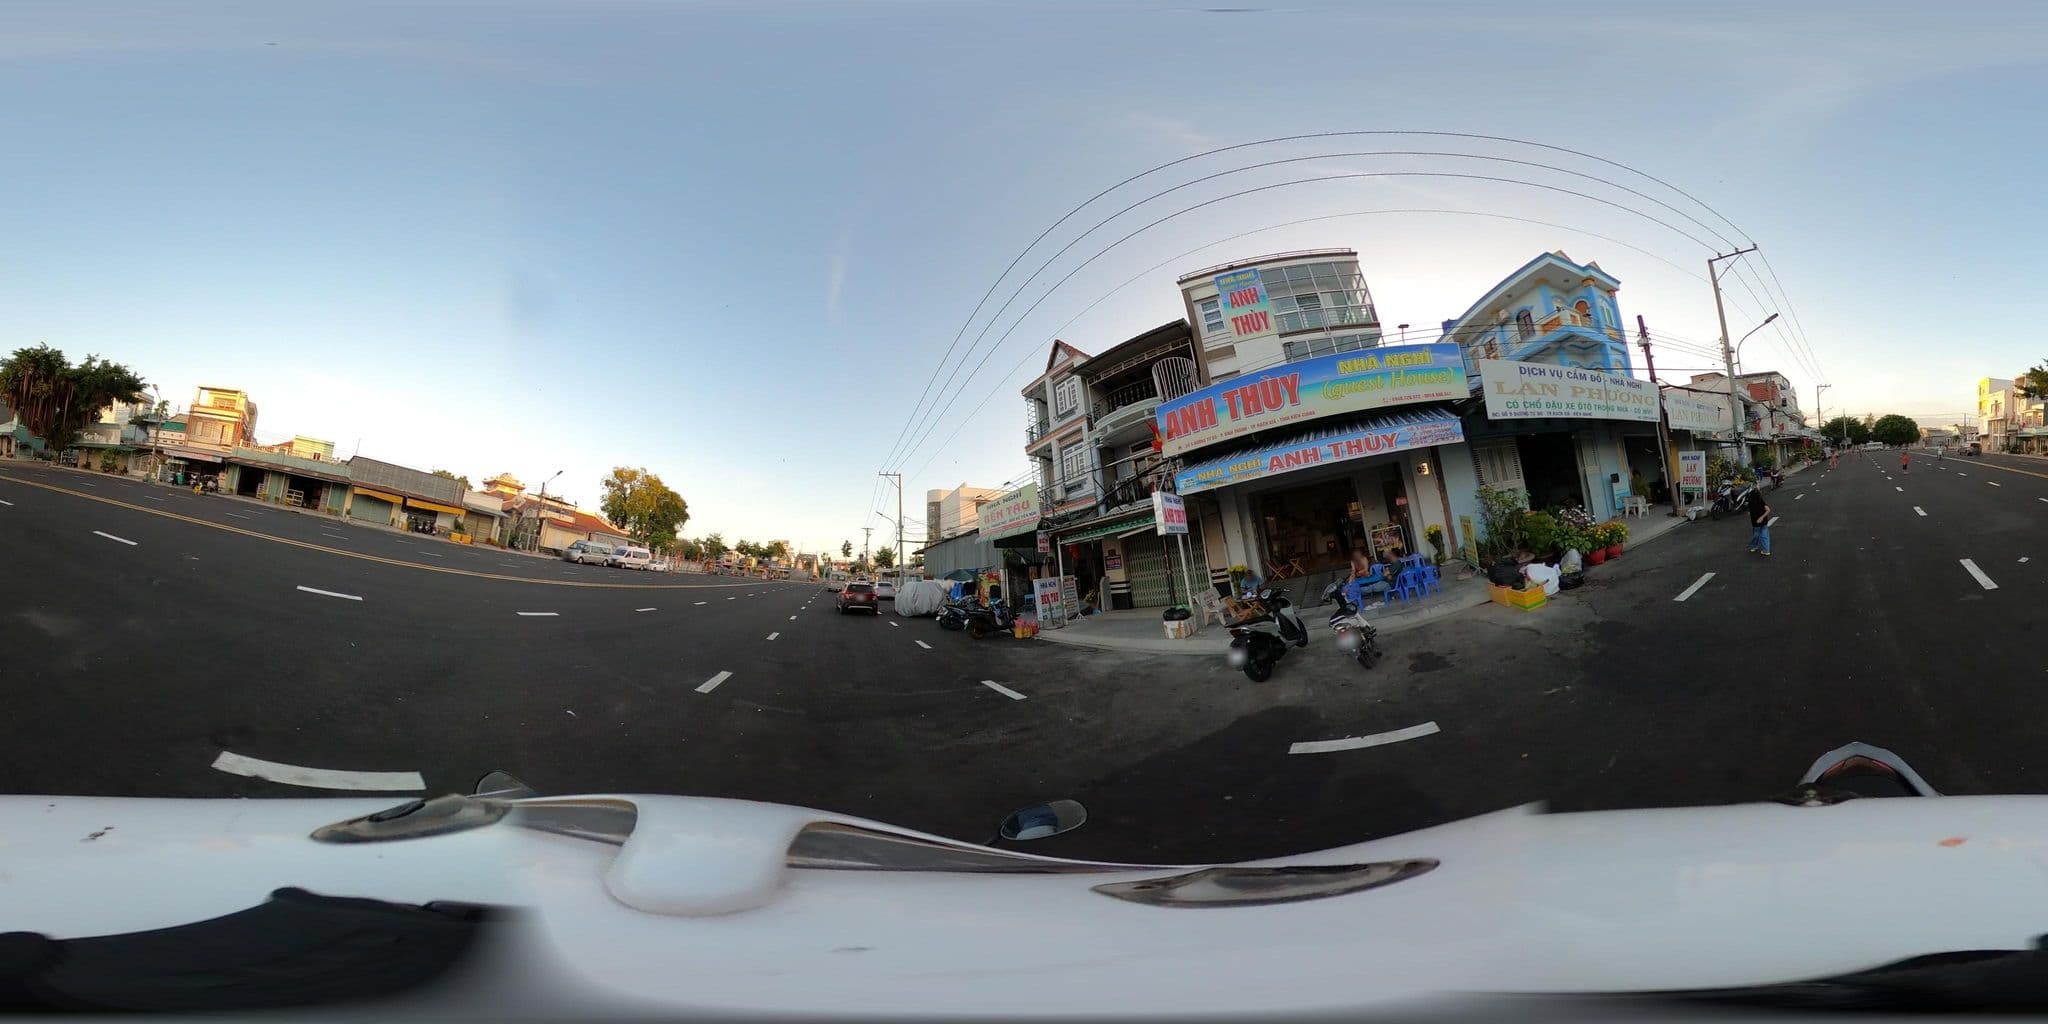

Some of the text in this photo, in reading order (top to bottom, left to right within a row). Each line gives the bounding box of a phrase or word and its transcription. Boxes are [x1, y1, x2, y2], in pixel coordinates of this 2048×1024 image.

[1229, 287, 1260, 309] ANH
[1231, 309, 1269, 336] THÙY
[1337, 354, 1381, 375] NHÀ
[1519, 366, 1546, 378] DỊCH
[1549, 368, 1563, 380] VỤ
[1566, 368, 1587, 381] CẦM
[1609, 375, 1625, 388] NHÀ
[1495, 381, 1559, 396] LAN
[1570, 386, 1655, 406] PHƯƠNG
[1505, 398, 1519, 409] CÓ
[1565, 402, 1577, 410] XE
[1165, 372, 1301, 442] ANH THÙY
[1268, 445, 1321, 472] ANH
[1327, 432, 1399, 460] THÙY
[1198, 465, 1224, 481] NHÀ
